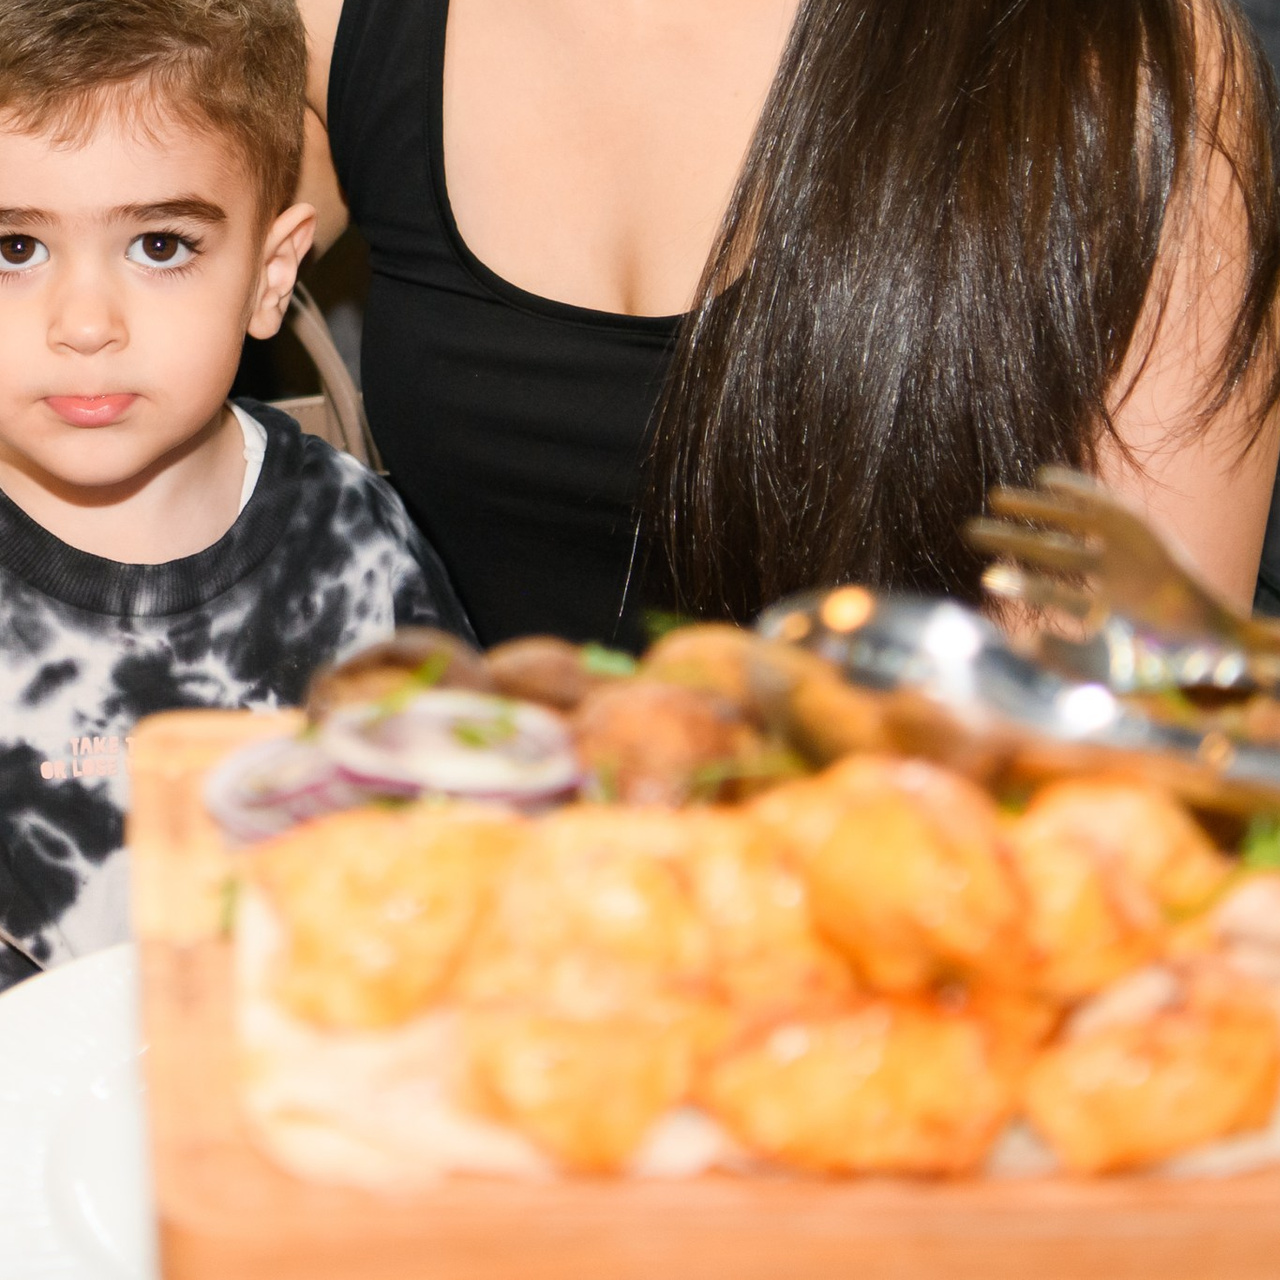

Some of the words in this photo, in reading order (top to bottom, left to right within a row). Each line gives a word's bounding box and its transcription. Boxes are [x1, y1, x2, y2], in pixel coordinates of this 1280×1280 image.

[70, 736, 119, 756] TAKE
[39, 760, 67, 780] OR
[72, 759, 118, 778] LOSE
